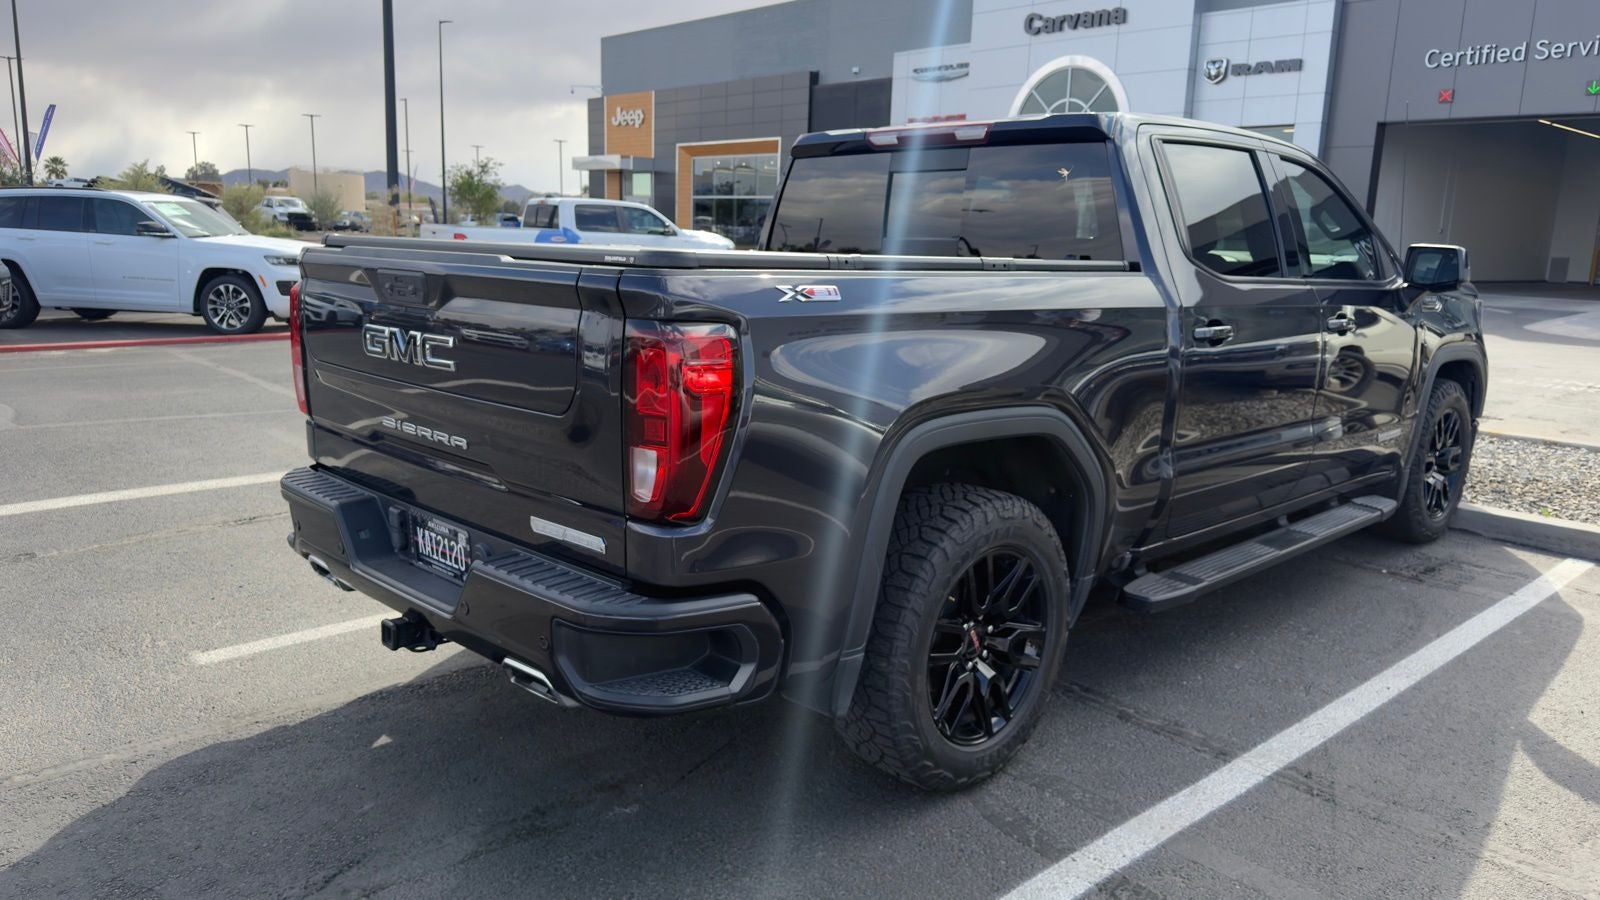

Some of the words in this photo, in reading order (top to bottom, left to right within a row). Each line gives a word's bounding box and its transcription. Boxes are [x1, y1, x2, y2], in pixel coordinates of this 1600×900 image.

[1024, 7, 1127, 36] Carvana
[1424, 42, 1527, 68] Certified
[1534, 35, 1600, 60] Servi
[1231, 59, 1303, 76] RAM
[612, 106, 645, 128] Jeep
[362, 323, 455, 372] GMC
[382, 416, 468, 450] SIERRA
